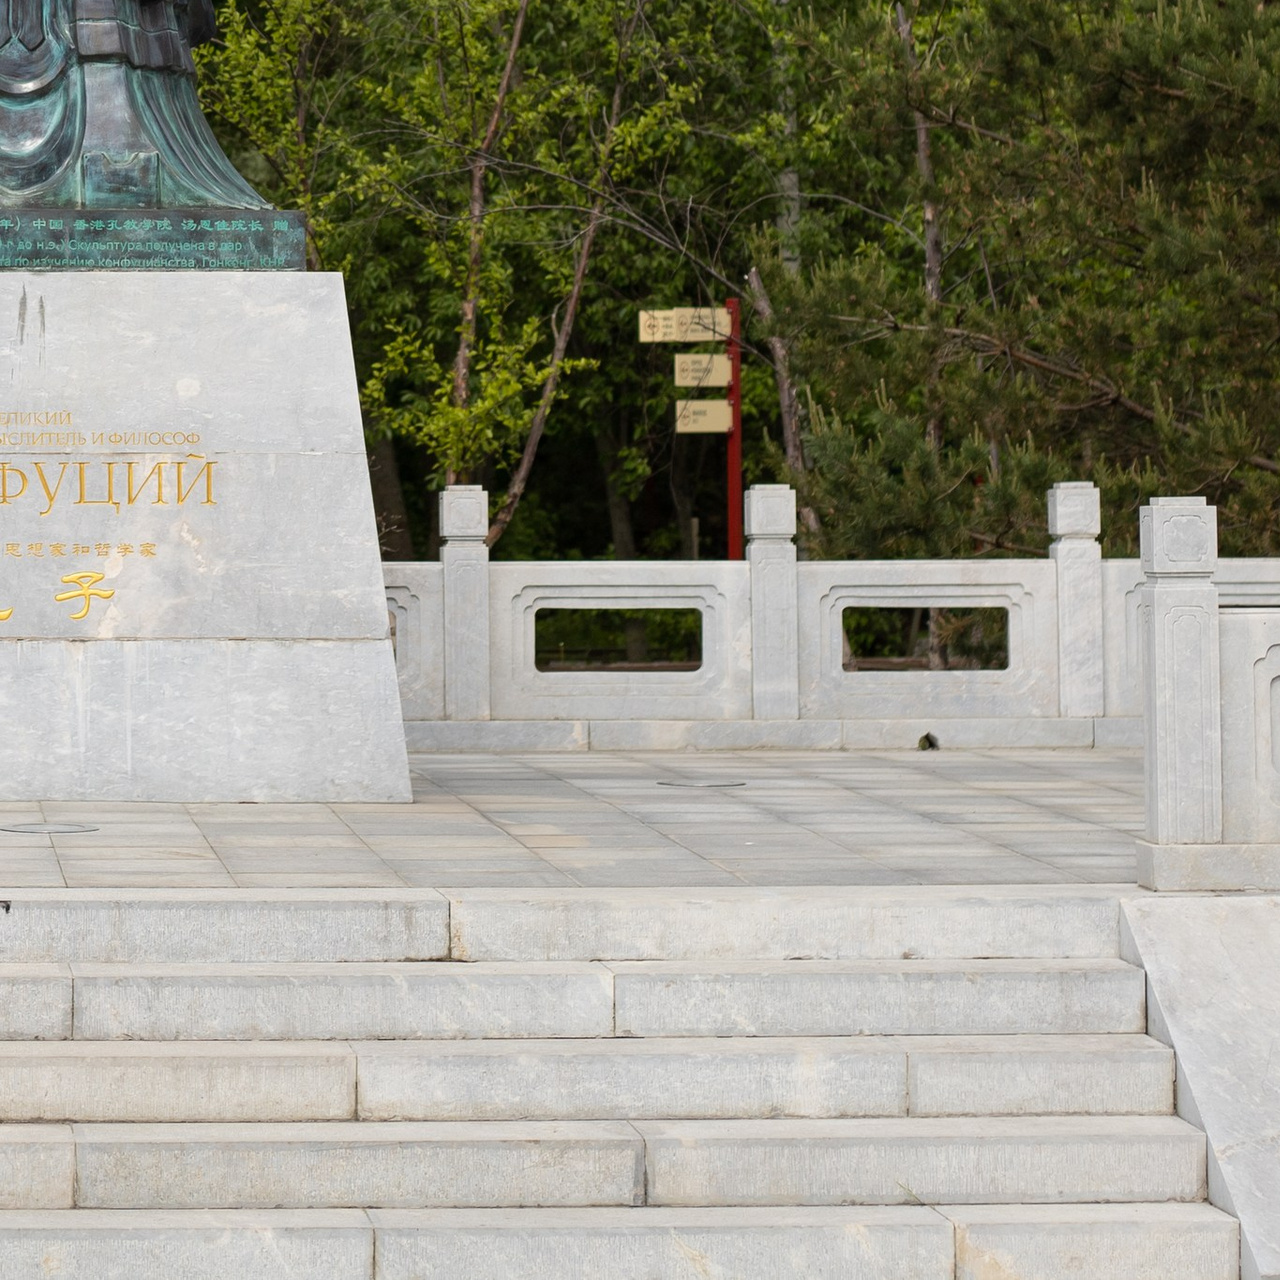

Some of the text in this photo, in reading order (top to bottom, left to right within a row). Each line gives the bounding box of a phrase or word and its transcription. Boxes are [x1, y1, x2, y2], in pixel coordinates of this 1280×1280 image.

[32, 218, 64, 230] 中国
[17, 239, 33, 251] до
[69, 239, 143, 252] Скульптура
[145, 240, 205, 252] получена
[208, 241, 215, 250] в
[219, 240, 243, 253] дар
[14, 257, 30, 267] по
[33, 256, 95, 267] изучению
[91, 431, 104, 446] И
[108, 430, 201, 446] ФИЛОСОФ
